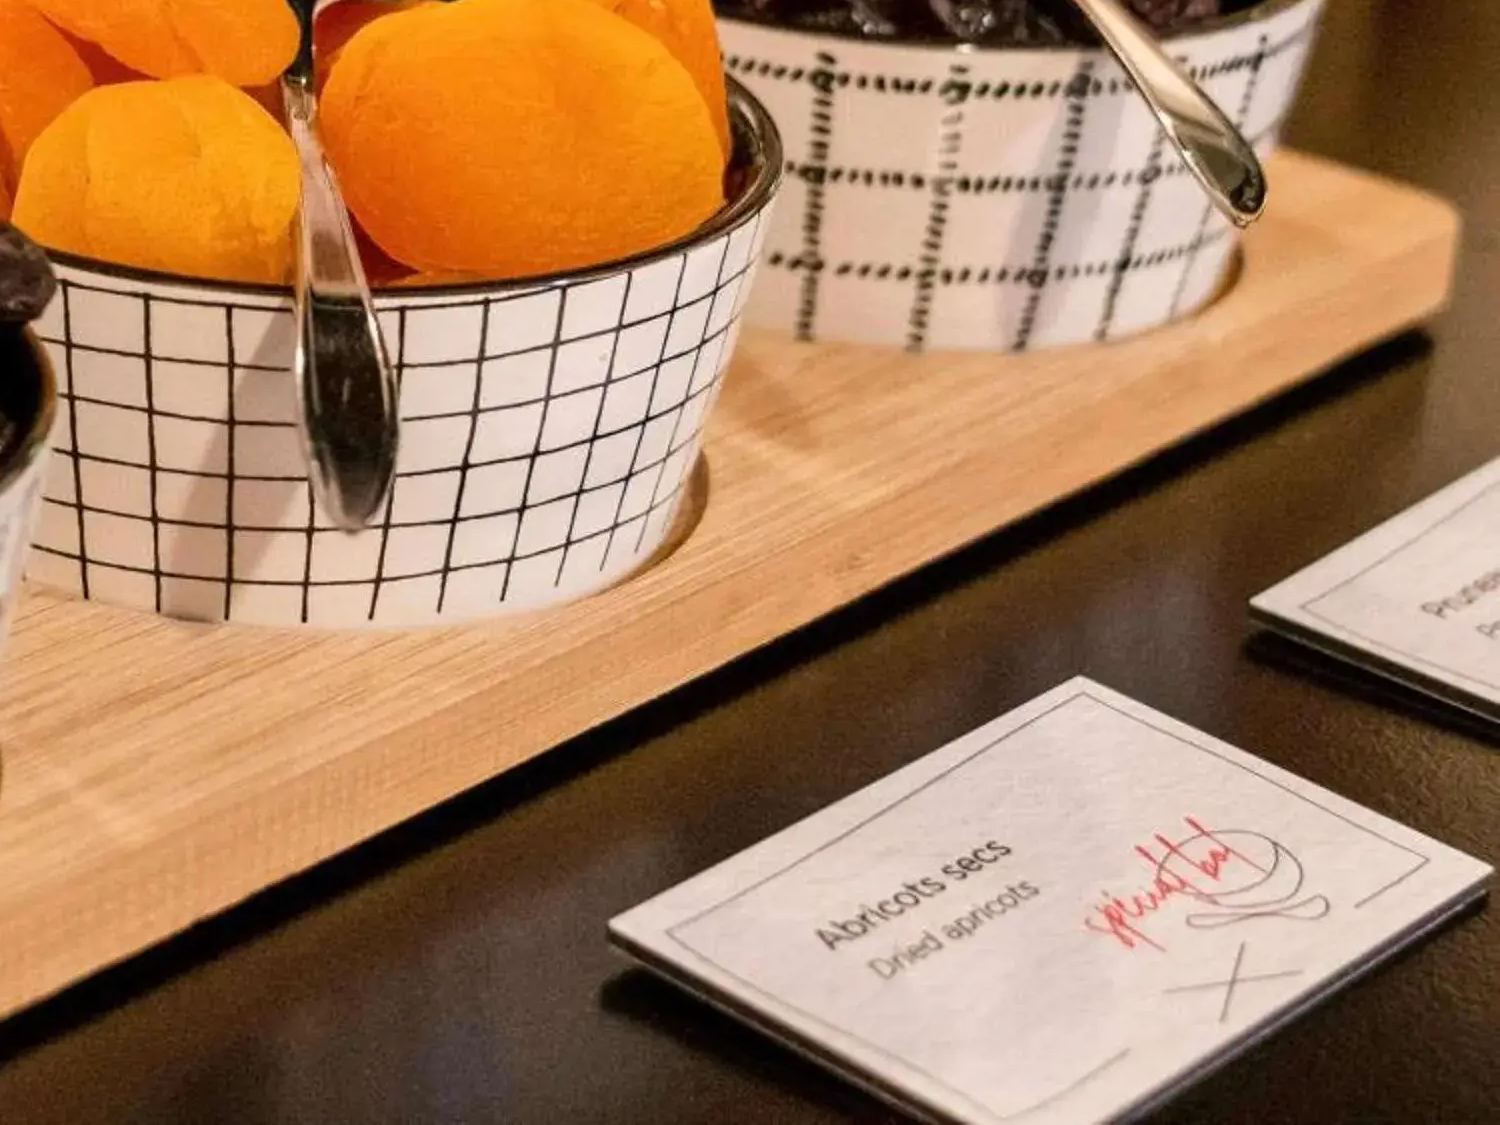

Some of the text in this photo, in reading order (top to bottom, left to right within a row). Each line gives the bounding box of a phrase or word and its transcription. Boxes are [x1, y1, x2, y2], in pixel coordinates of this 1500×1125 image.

[816, 840, 1012, 950] Abricots secs
[867, 881, 1041, 980] Dried apricots
